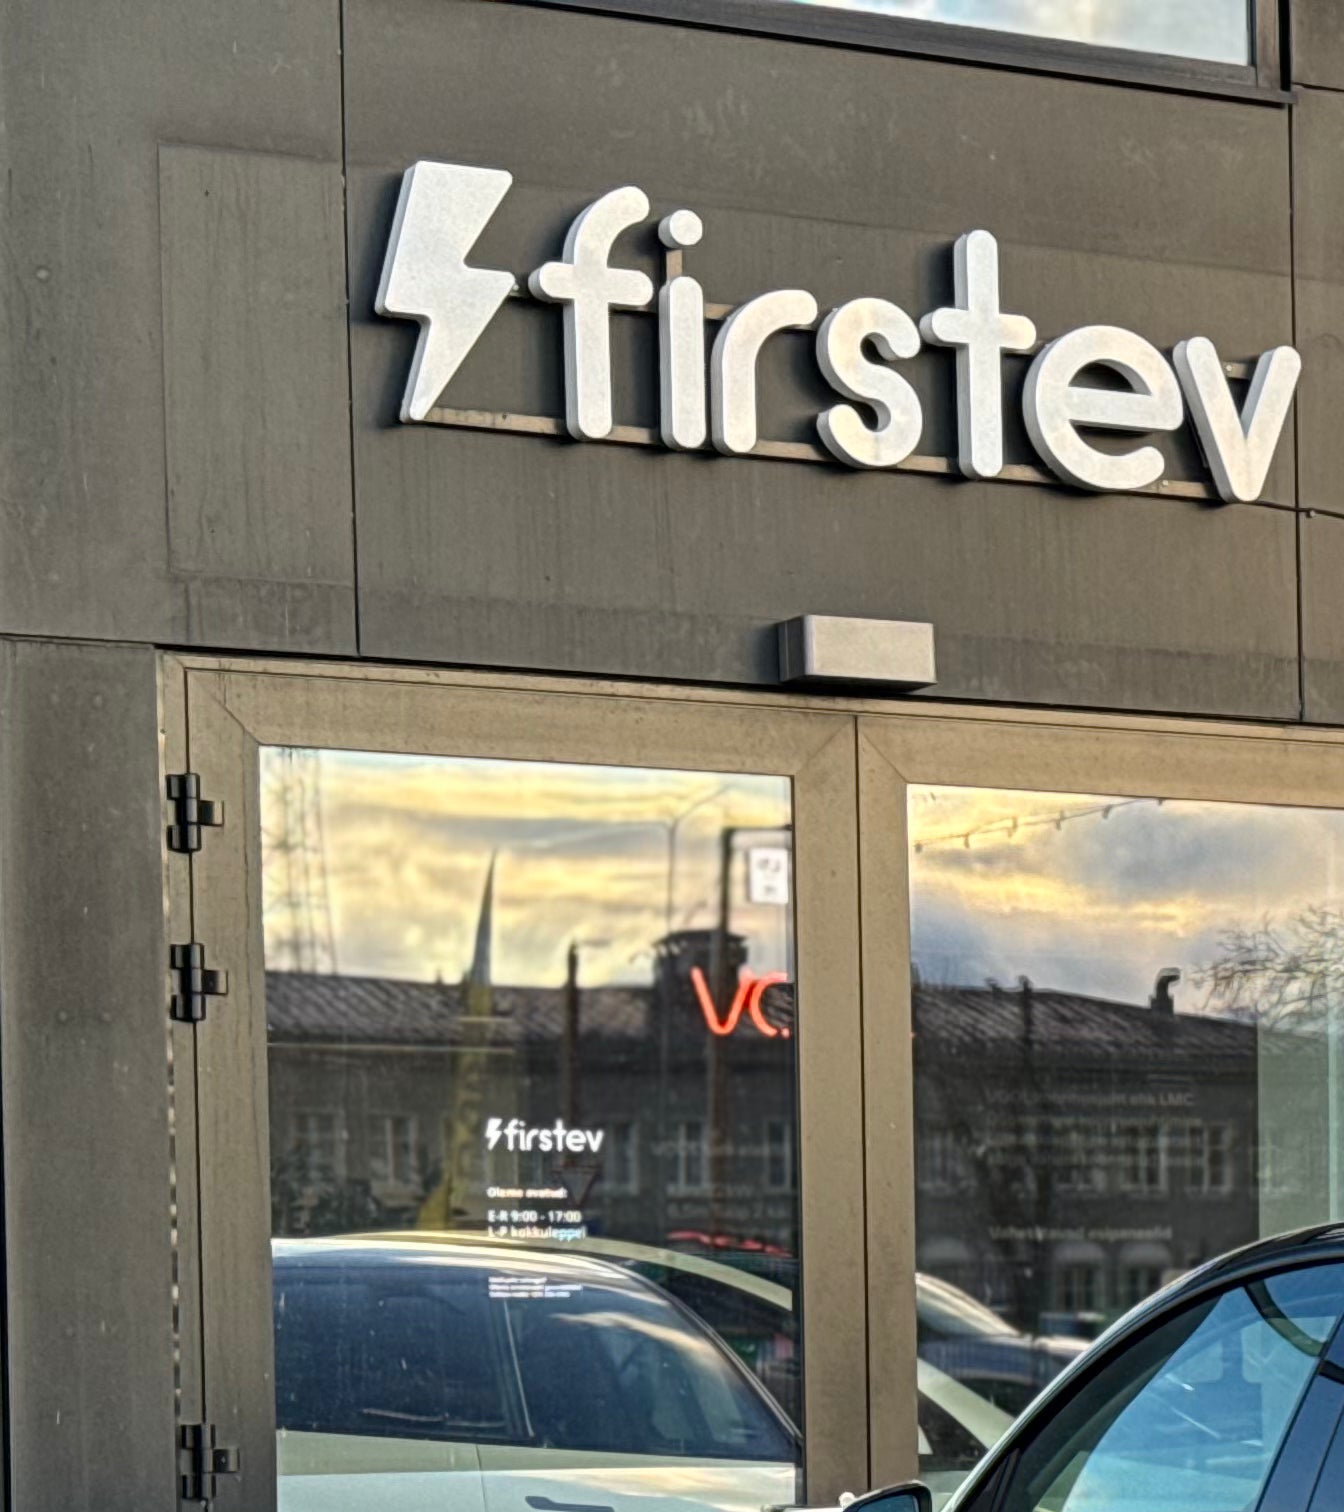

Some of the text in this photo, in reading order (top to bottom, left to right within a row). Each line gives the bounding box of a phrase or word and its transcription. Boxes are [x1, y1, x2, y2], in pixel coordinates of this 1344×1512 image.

[528, 185, 1302, 504] firstev
[503, 1117, 604, 1152] firstev
[548, 1210, 582, 1223] 17:00
